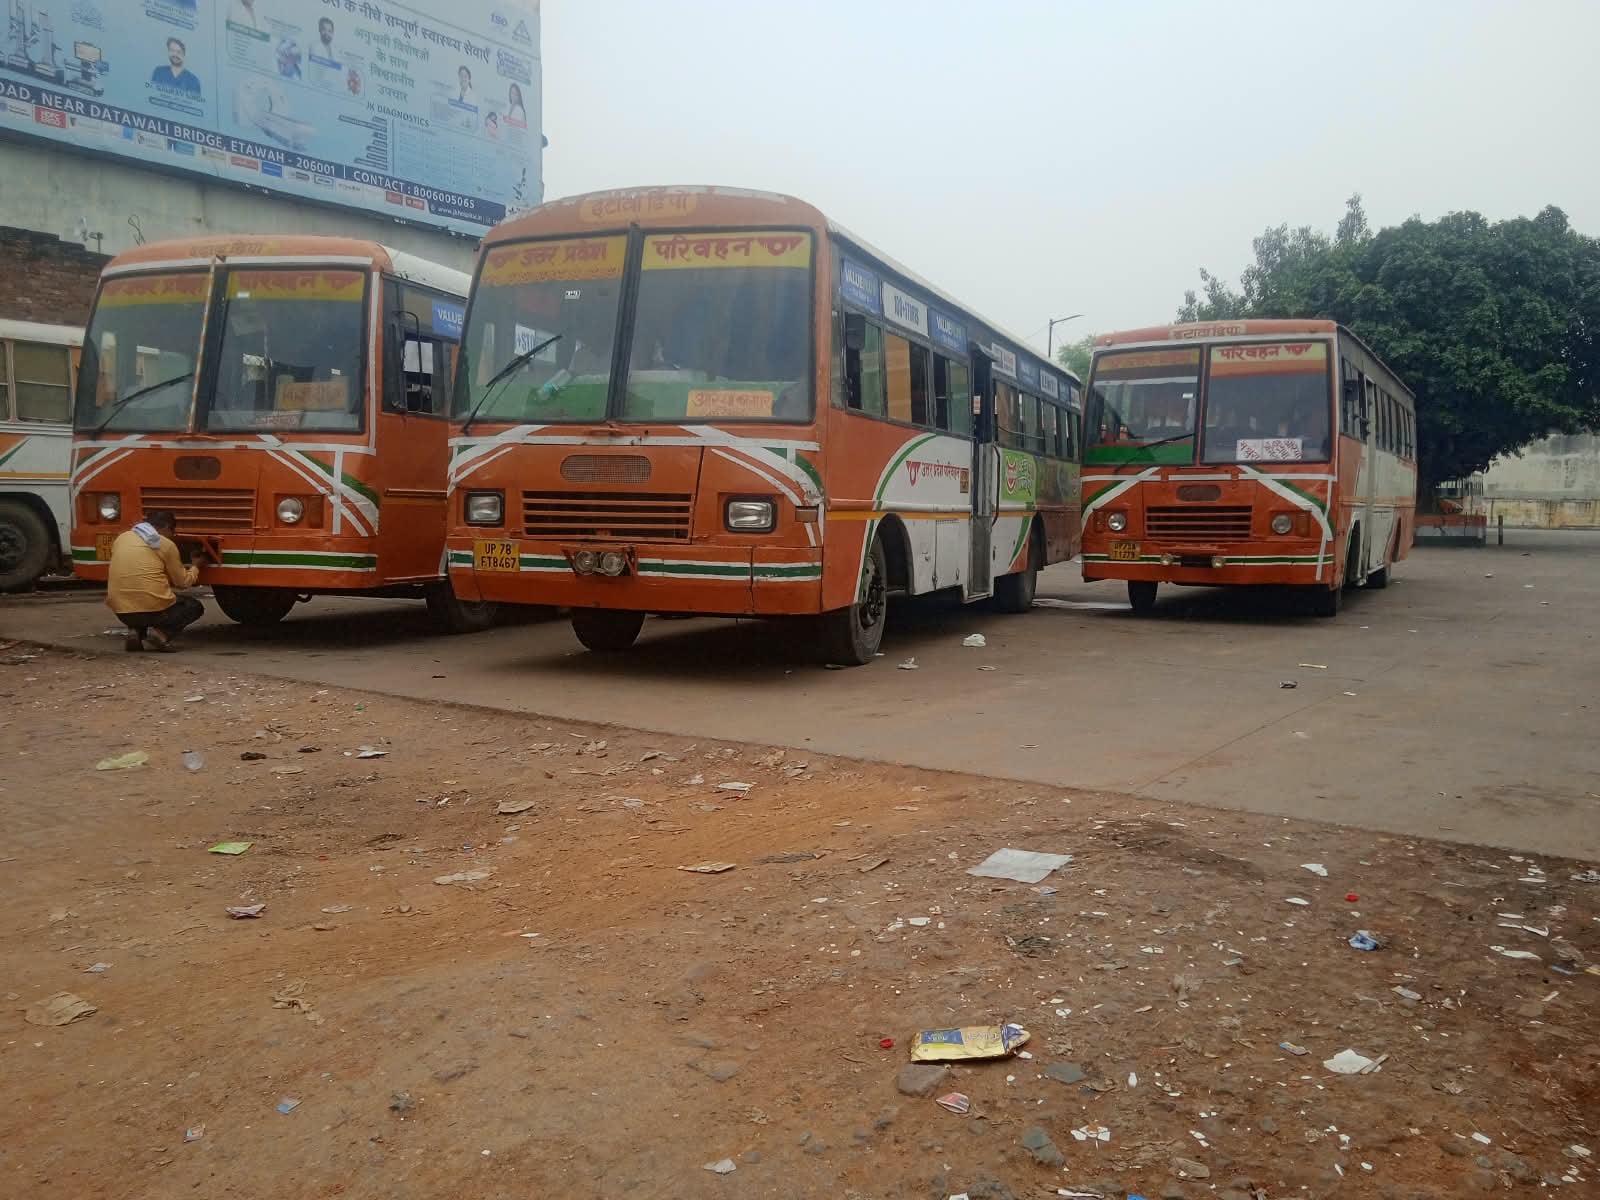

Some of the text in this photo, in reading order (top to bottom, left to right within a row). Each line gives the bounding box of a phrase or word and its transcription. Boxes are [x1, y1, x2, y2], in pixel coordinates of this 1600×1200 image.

[377, 104, 430, 128] DIAGNOSTICS
[41, 91, 84, 114] NEAR
[90, 103, 169, 134] DATAWALI
[174, 125, 226, 151] BRIDGE,
[231, 141, 285, 164] ETAWAH
[296, 153, 335, 177] 206001
[353, 170, 404, 195] CONTACT
[652, 237, 751, 263] परिवहन
[1217, 345, 1281, 360] परिवहन
[484, 543, 497, 554] UP
